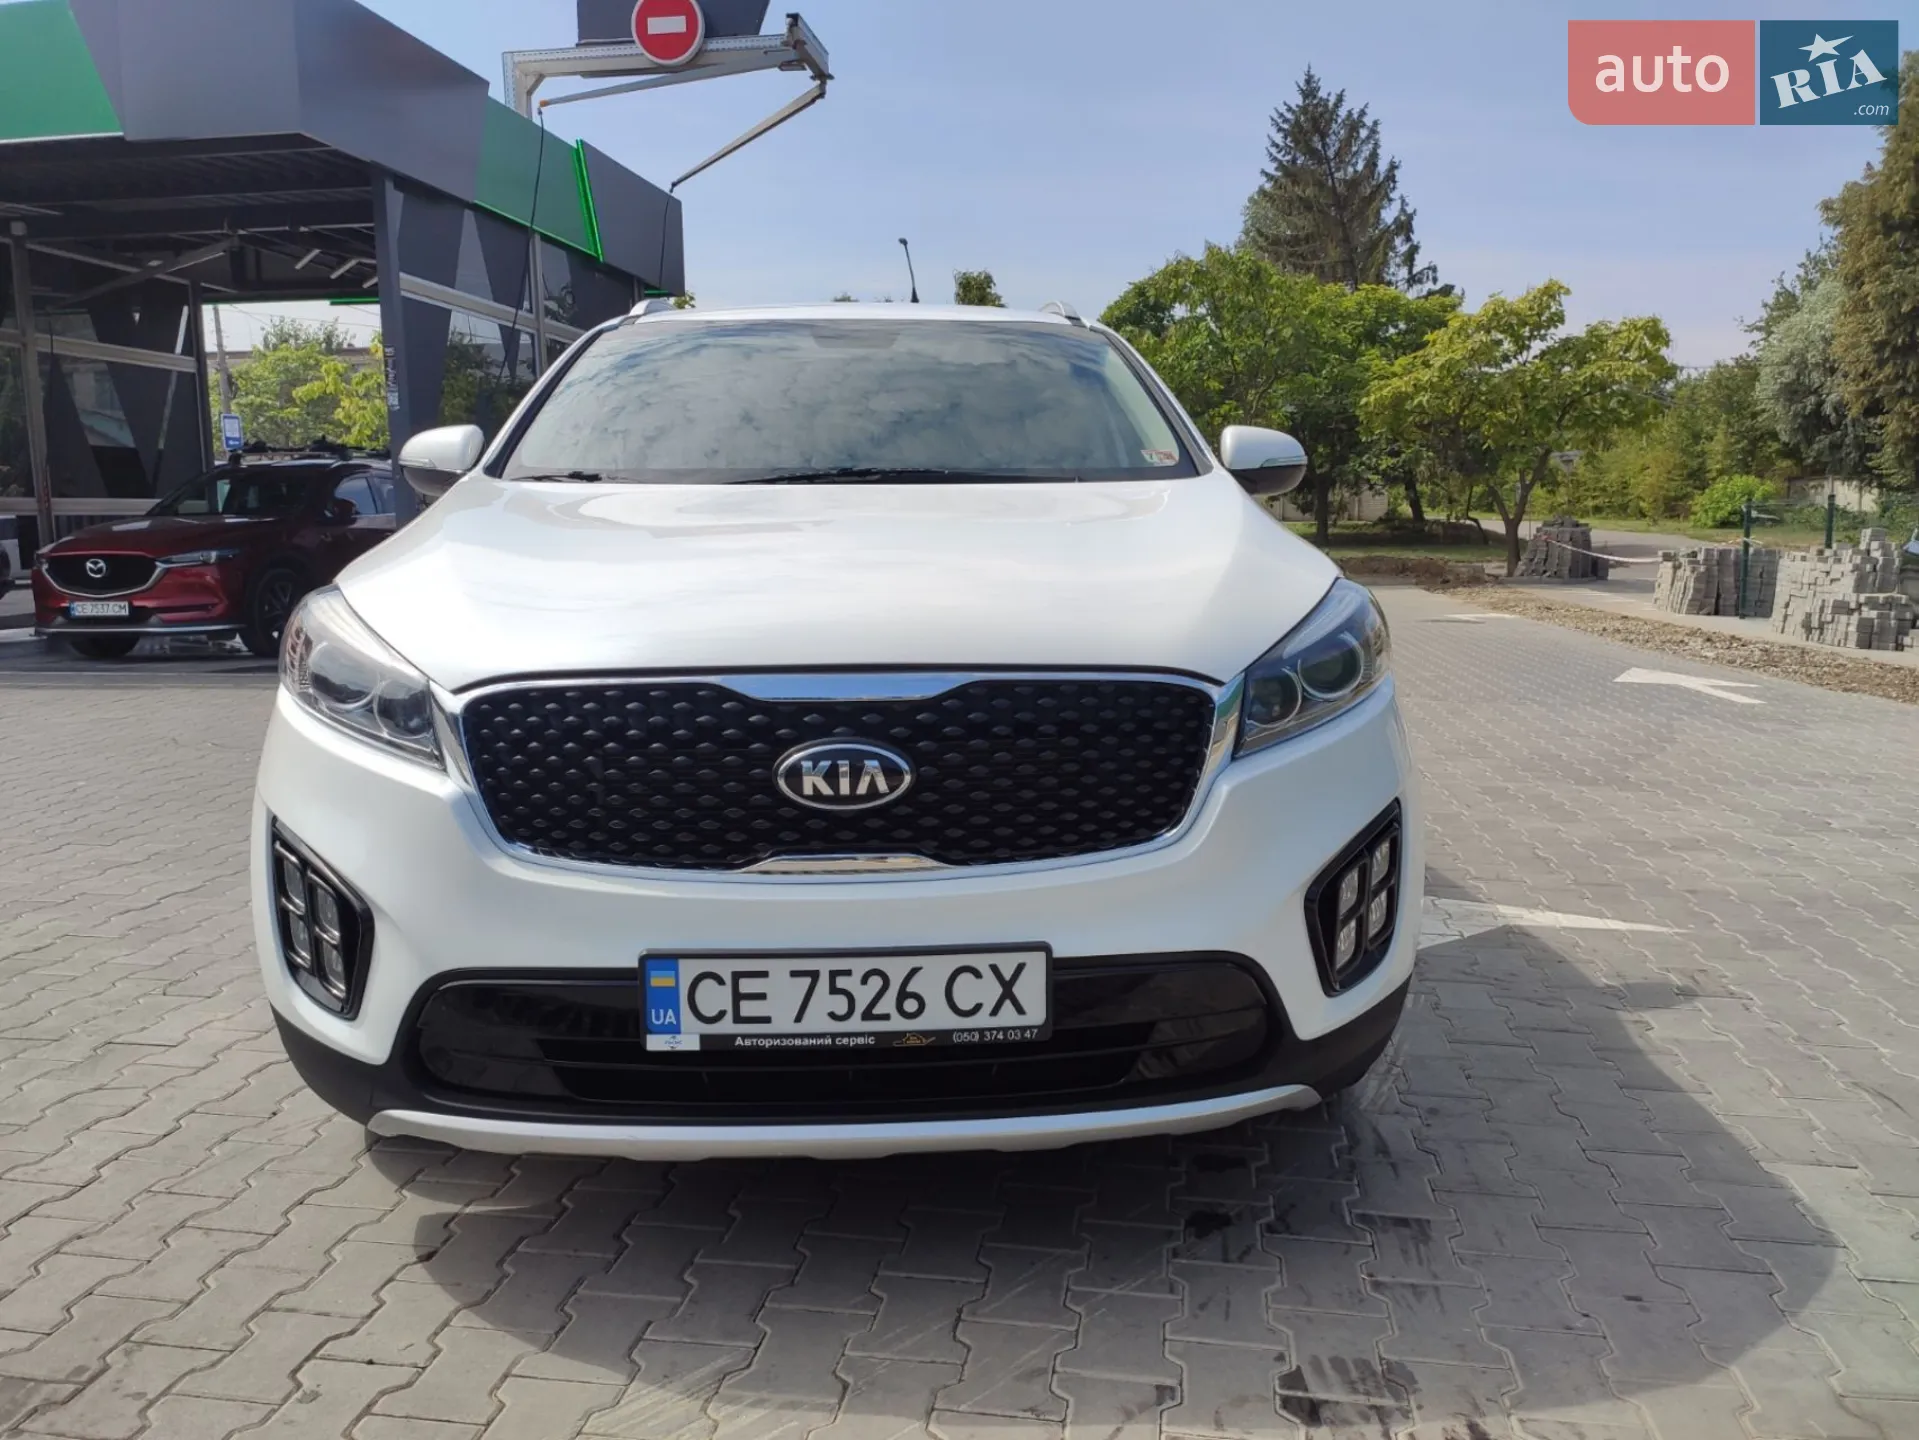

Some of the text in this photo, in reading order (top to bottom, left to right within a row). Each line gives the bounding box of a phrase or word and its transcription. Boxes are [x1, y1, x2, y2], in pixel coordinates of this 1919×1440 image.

[800, 759, 890, 796] KIA
[686, 961, 1027, 1025] CE 7526 CX
[651, 1008, 677, 1025] UA
[734, 1034, 876, 1048] Авторизований сервіс
[952, 1028, 1039, 1043] (050) 374 03 47
